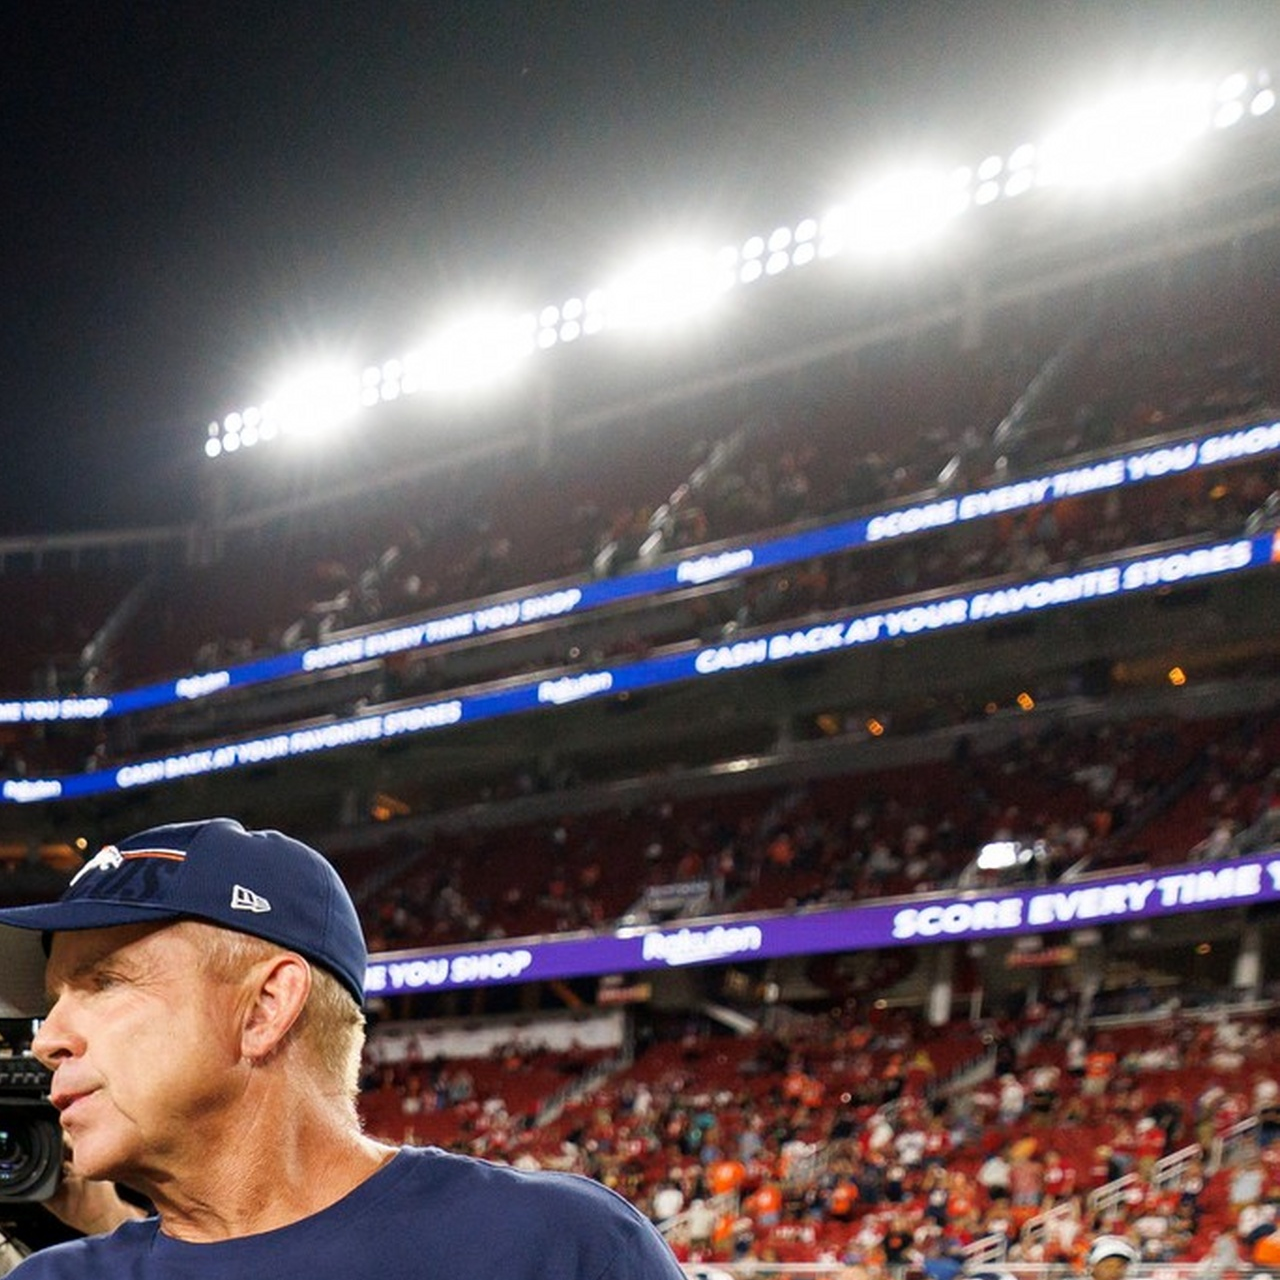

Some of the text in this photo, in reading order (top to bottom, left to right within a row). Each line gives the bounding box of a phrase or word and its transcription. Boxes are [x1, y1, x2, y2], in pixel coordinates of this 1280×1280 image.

[866, 499, 958, 541] SCORE
[958, 477, 1051, 520] EVERY
[1050, 459, 1125, 497] TIME
[1126, 442, 1198, 480] YOU
[695, 540, 1252, 674] CASH BACK AT YOUR FAVORITE STORES
[892, 899, 1023, 939] SCORE
[1027, 879, 1158, 925] EVERY
[1157, 864, 1262, 907] TIME
[389, 958, 449, 988] YOU
[450, 950, 532, 983] SHOP
